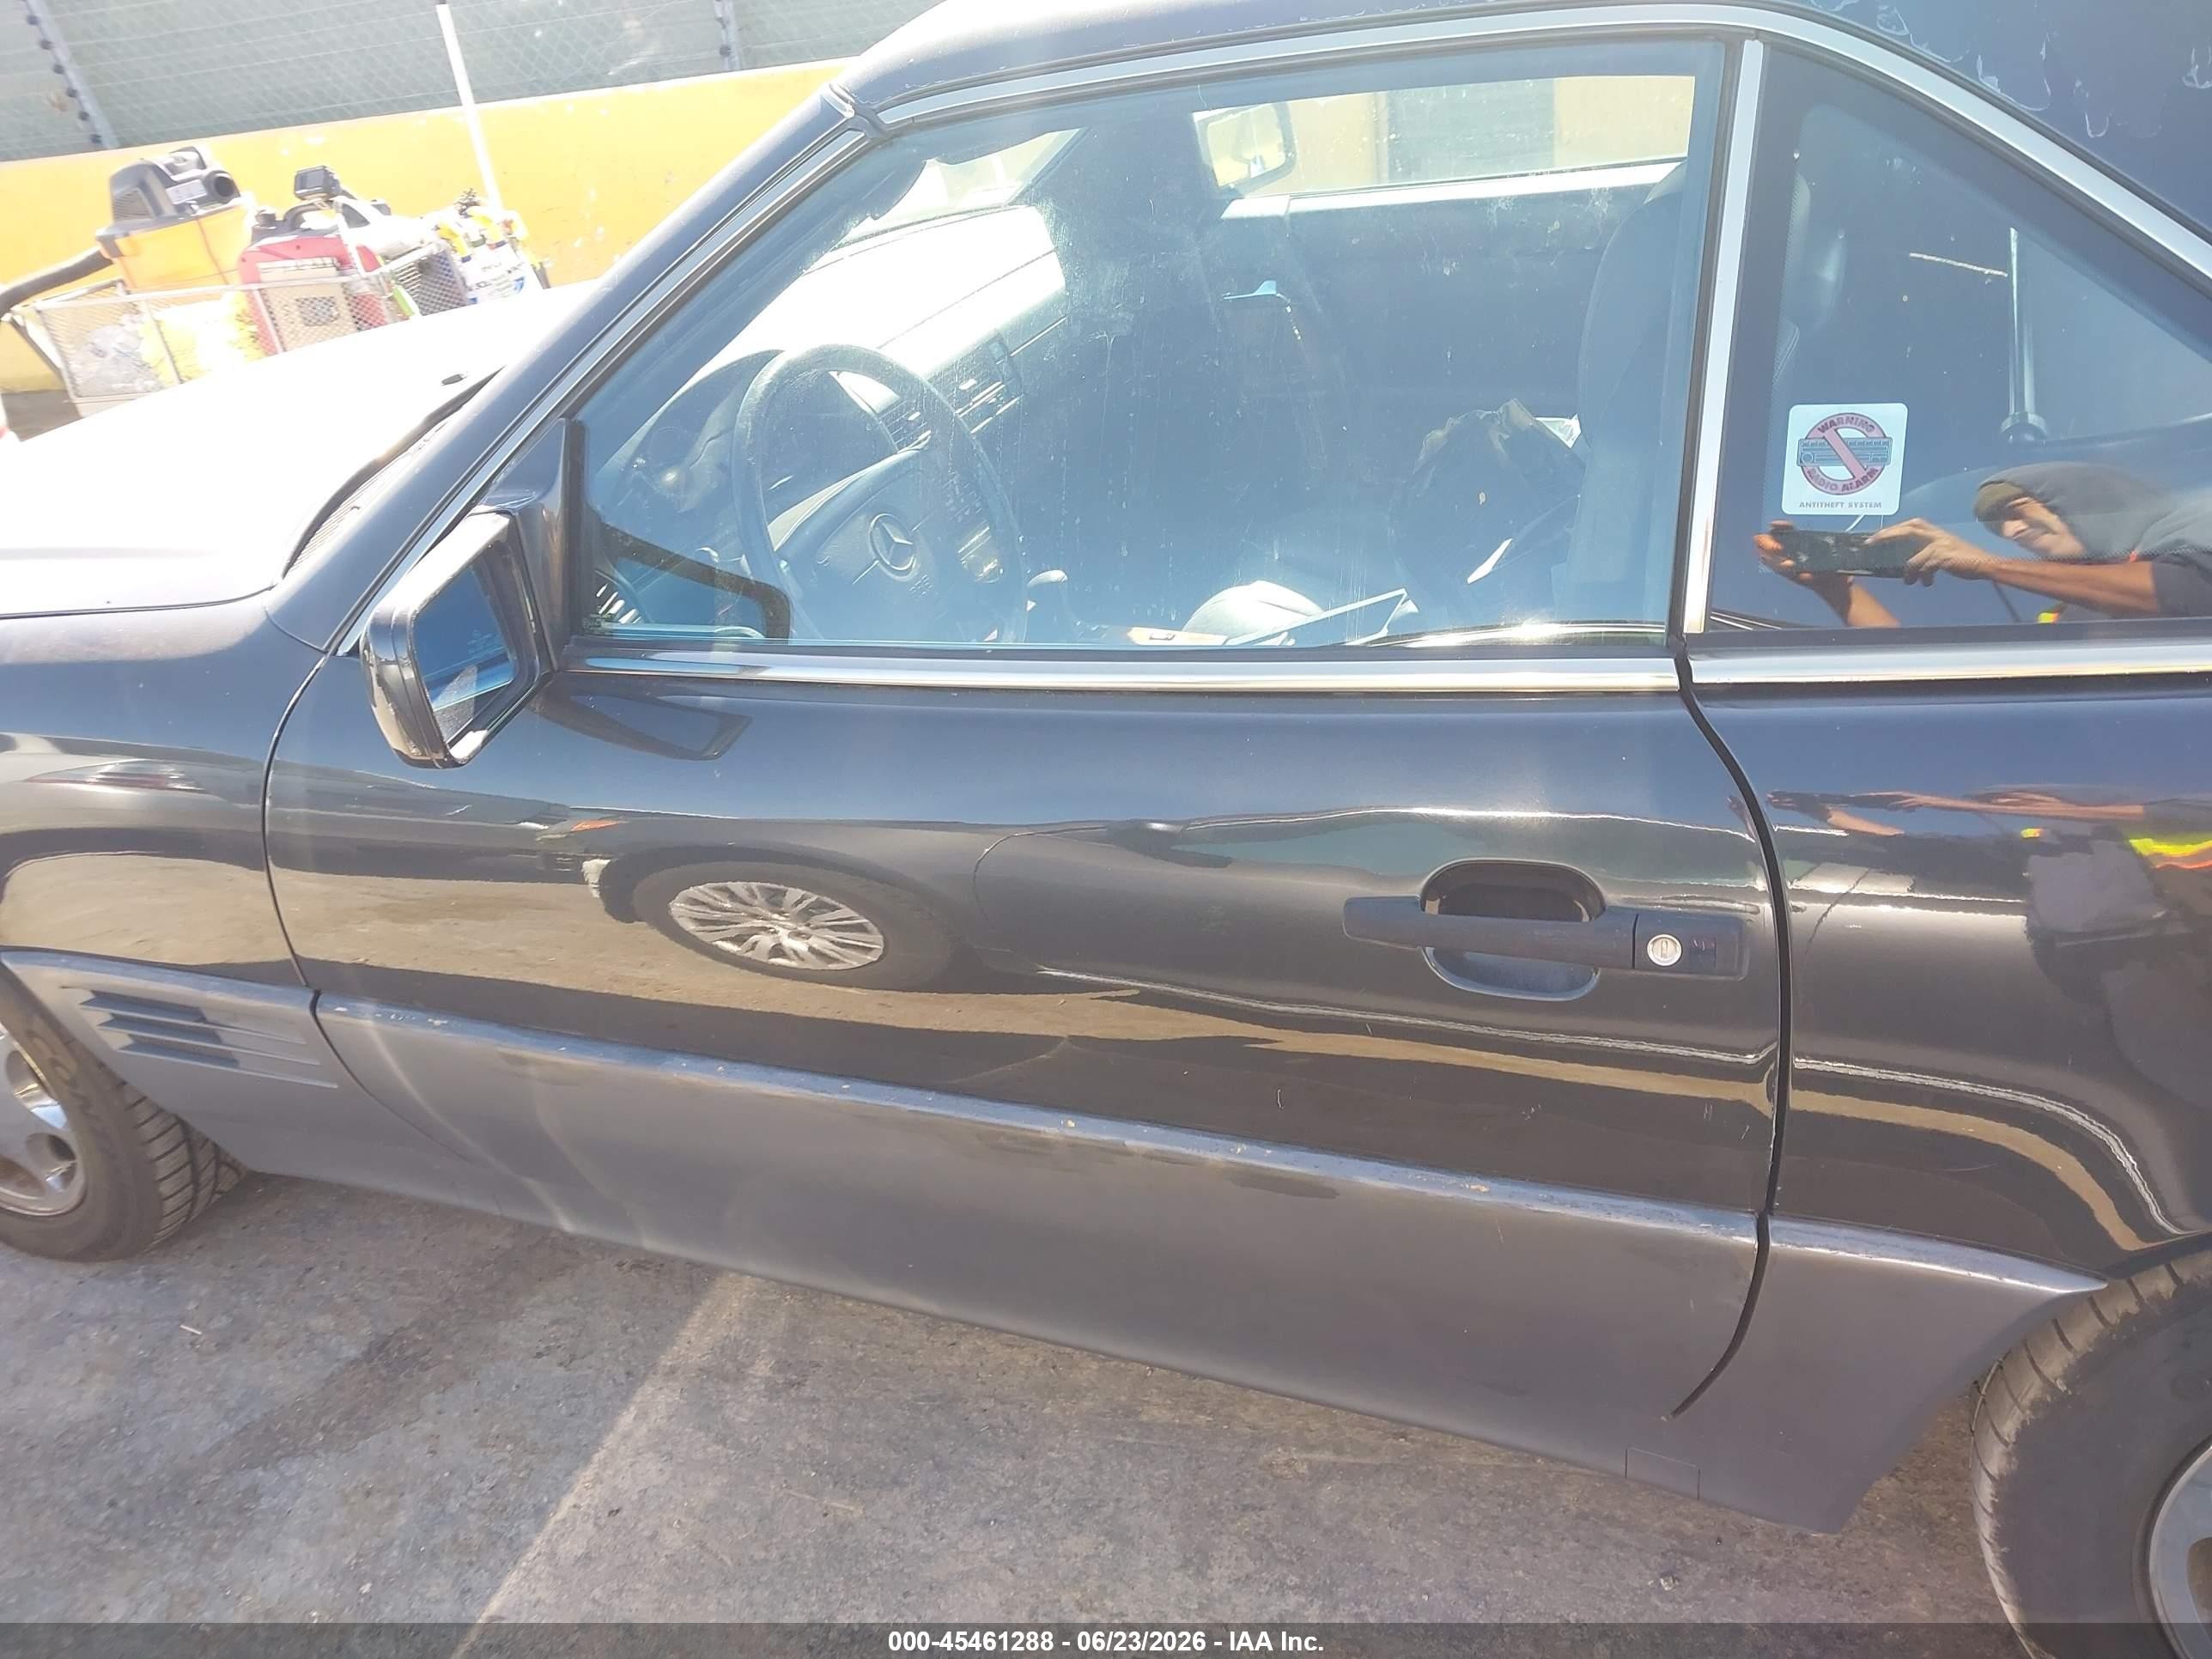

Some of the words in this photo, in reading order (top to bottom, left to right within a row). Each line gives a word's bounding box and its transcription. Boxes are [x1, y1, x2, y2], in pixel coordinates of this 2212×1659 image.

[1816, 416, 1876, 434] WARNING
[1807, 468, 1838, 491] RADIO
[1840, 467, 1879, 492] ALARM
